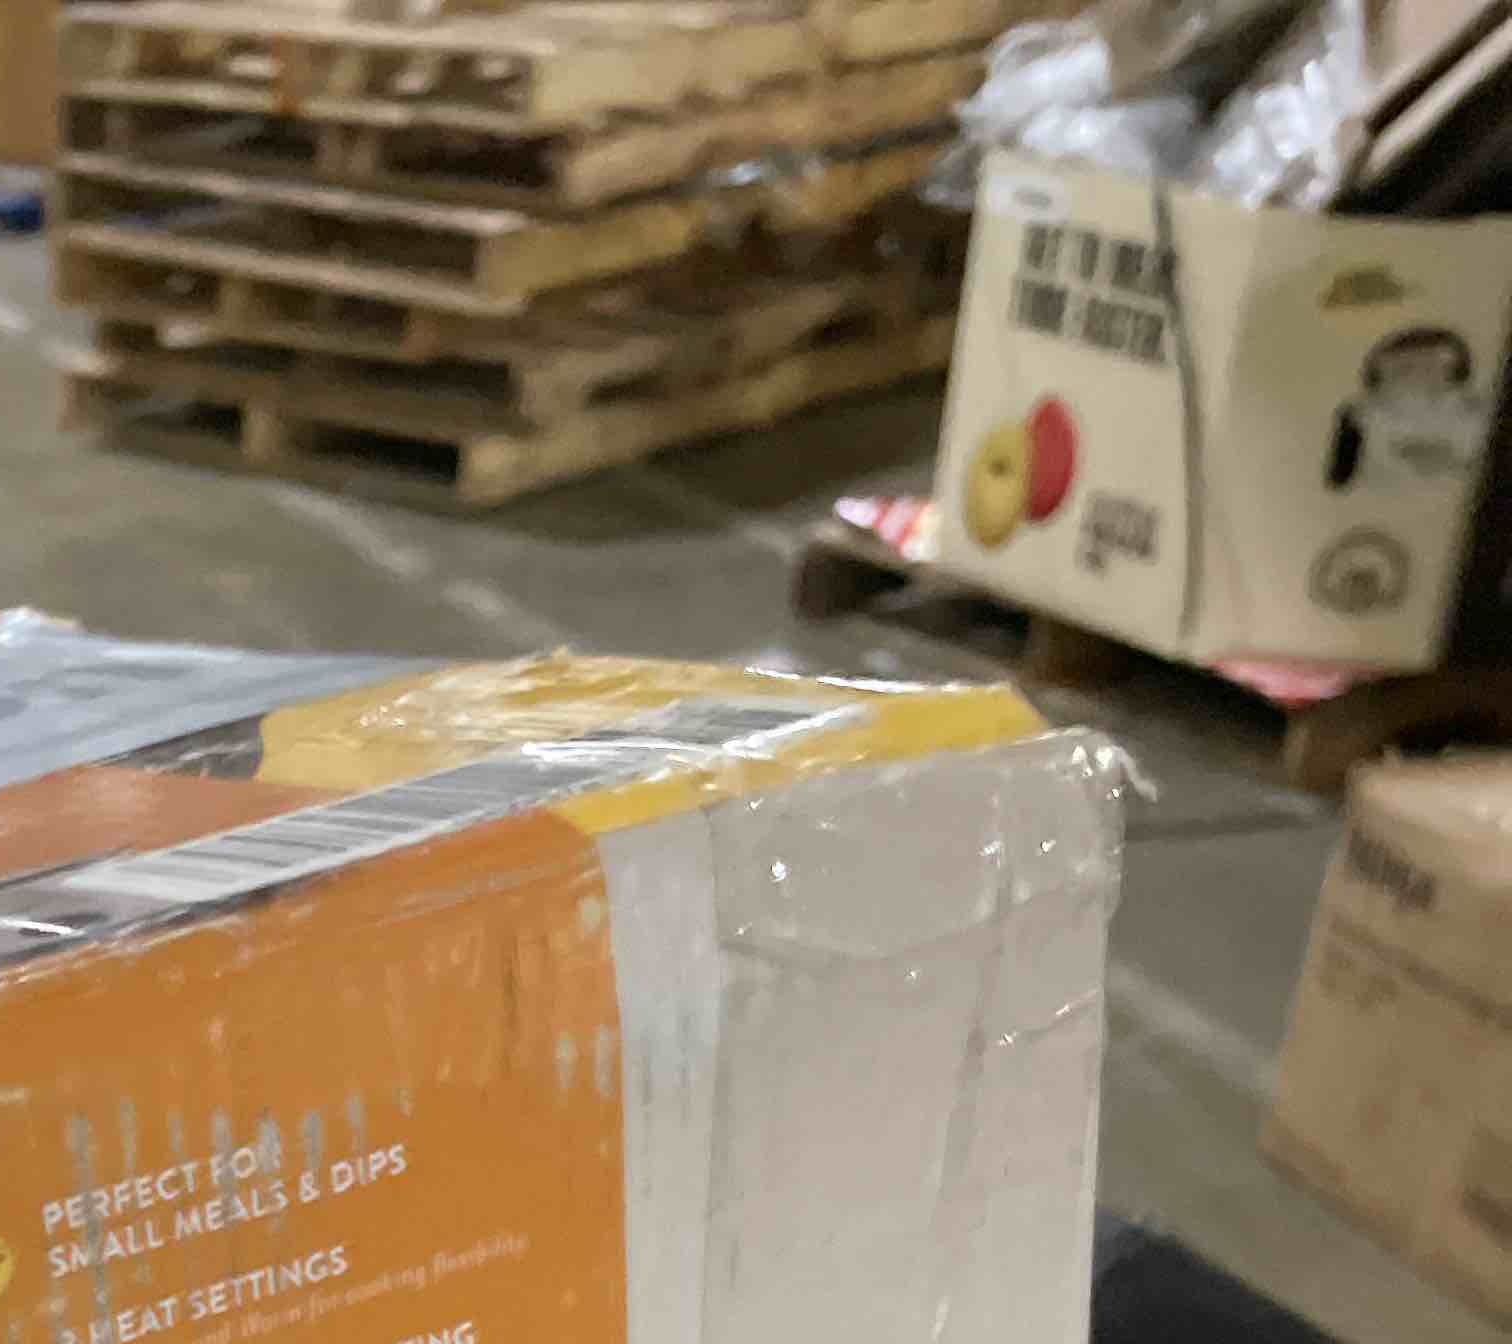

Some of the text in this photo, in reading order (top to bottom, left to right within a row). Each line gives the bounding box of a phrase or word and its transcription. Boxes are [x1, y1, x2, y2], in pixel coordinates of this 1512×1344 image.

[41, 1160, 201, 1235] PERFECT
[47, 1143, 408, 1279] SMALL MEALS & DIPS
[188, 1245, 349, 1321] SETTINGS
